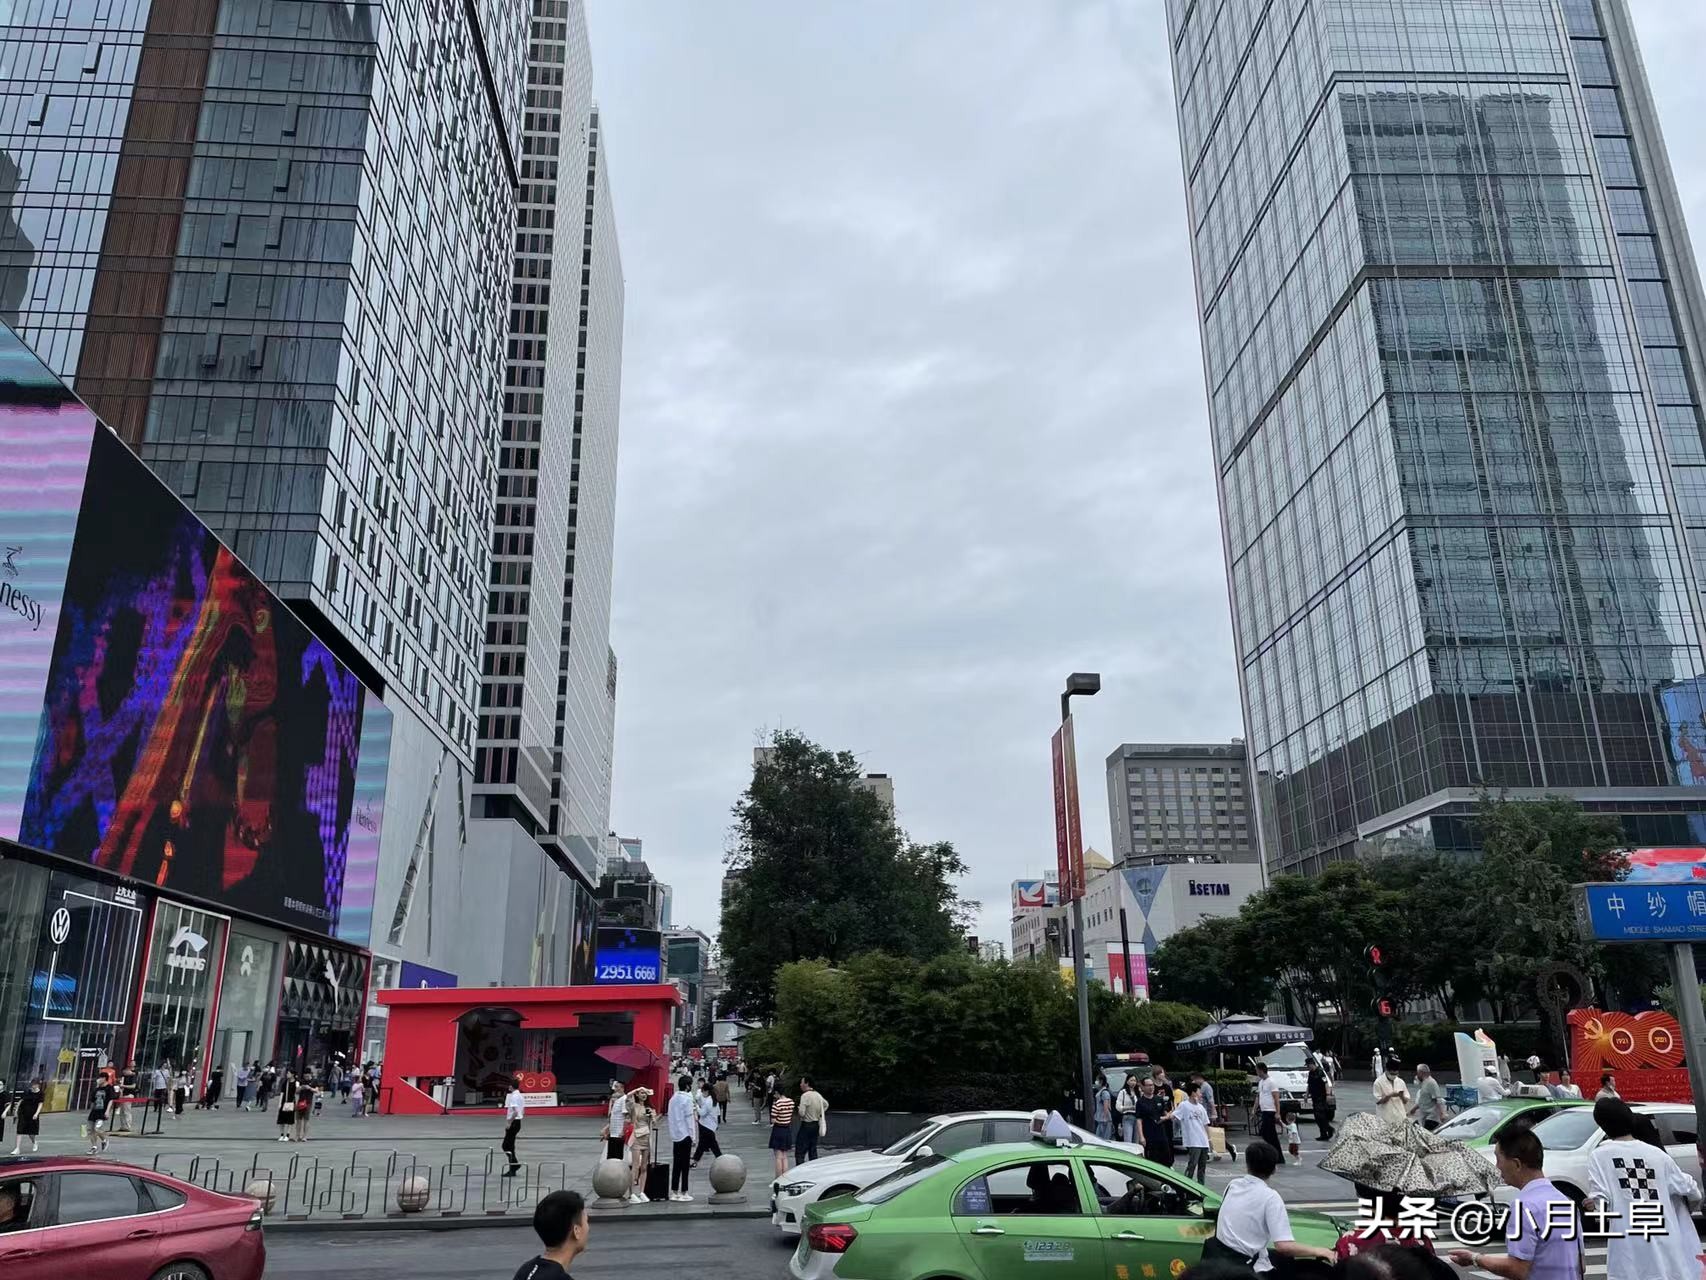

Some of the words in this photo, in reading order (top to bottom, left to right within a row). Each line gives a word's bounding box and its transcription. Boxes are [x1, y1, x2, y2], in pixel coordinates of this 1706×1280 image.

[1624, 926, 1650, 934] MIDDLE
[1653, 925, 1685, 934] SHAMAO
[600, 965, 632, 979] 2951
